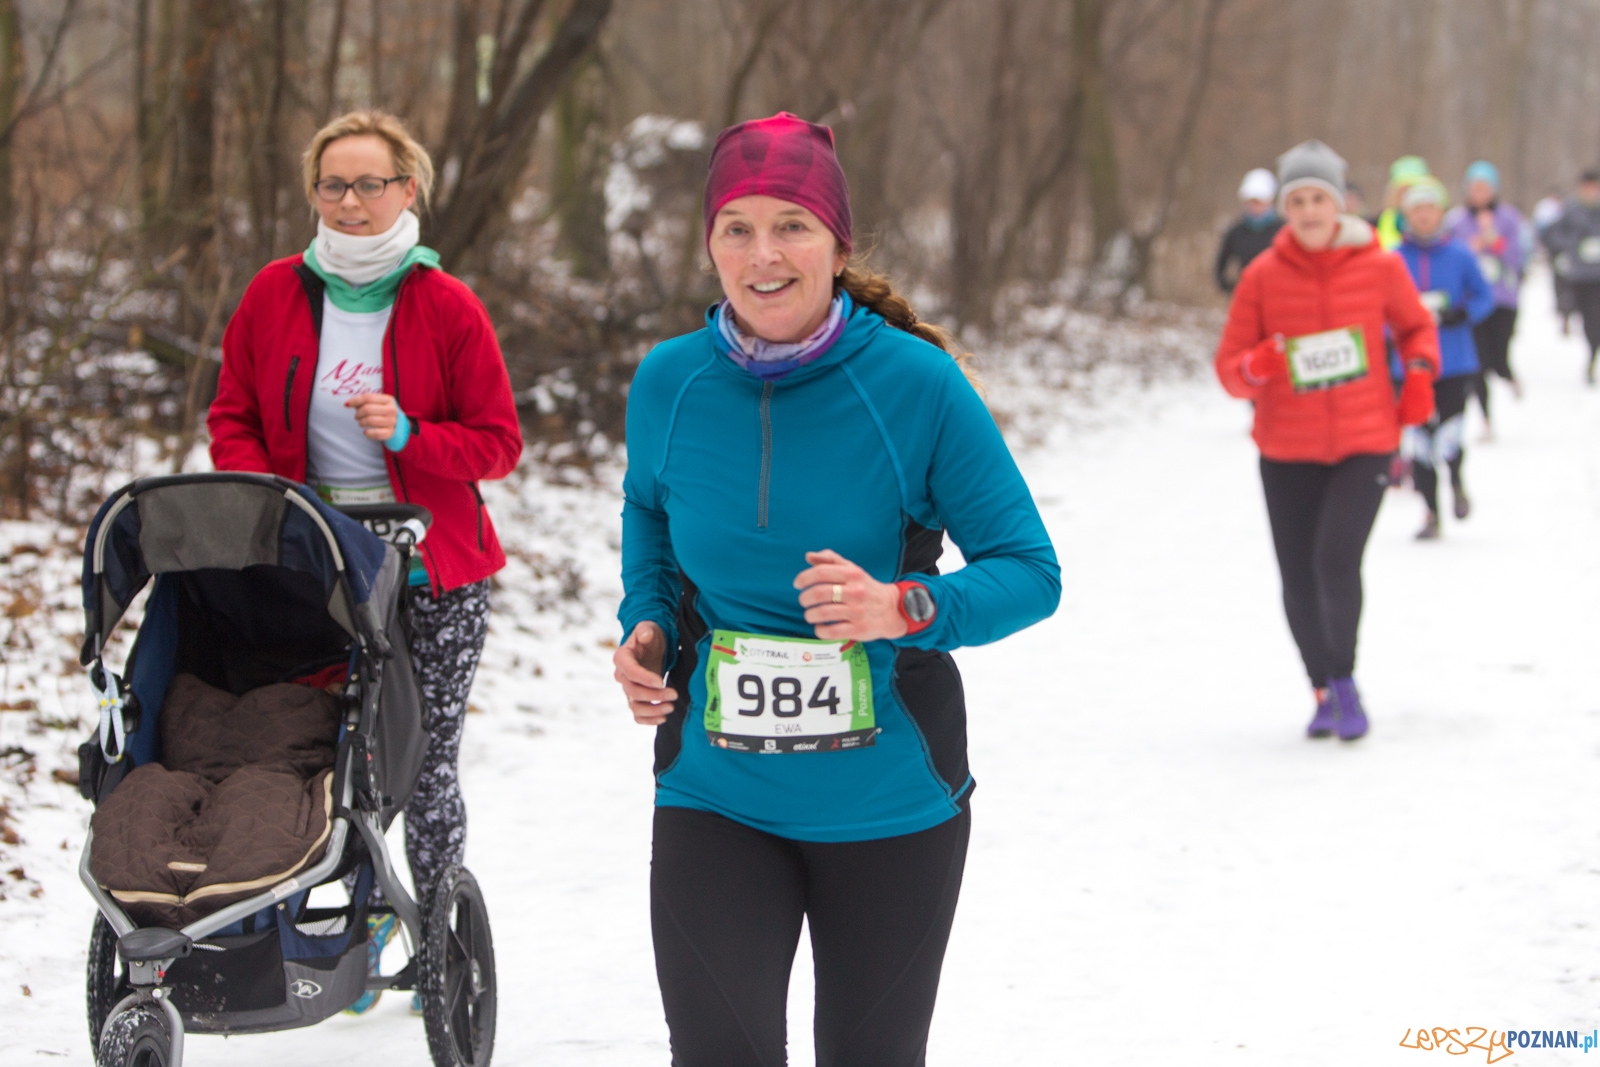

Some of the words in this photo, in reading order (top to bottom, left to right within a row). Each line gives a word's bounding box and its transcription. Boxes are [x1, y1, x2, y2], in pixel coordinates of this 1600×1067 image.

[1301, 345, 1351, 371] 1607
[737, 673, 841, 718] 984
[858, 678, 869, 717] Poznań
[774, 723, 803, 735] EWA
